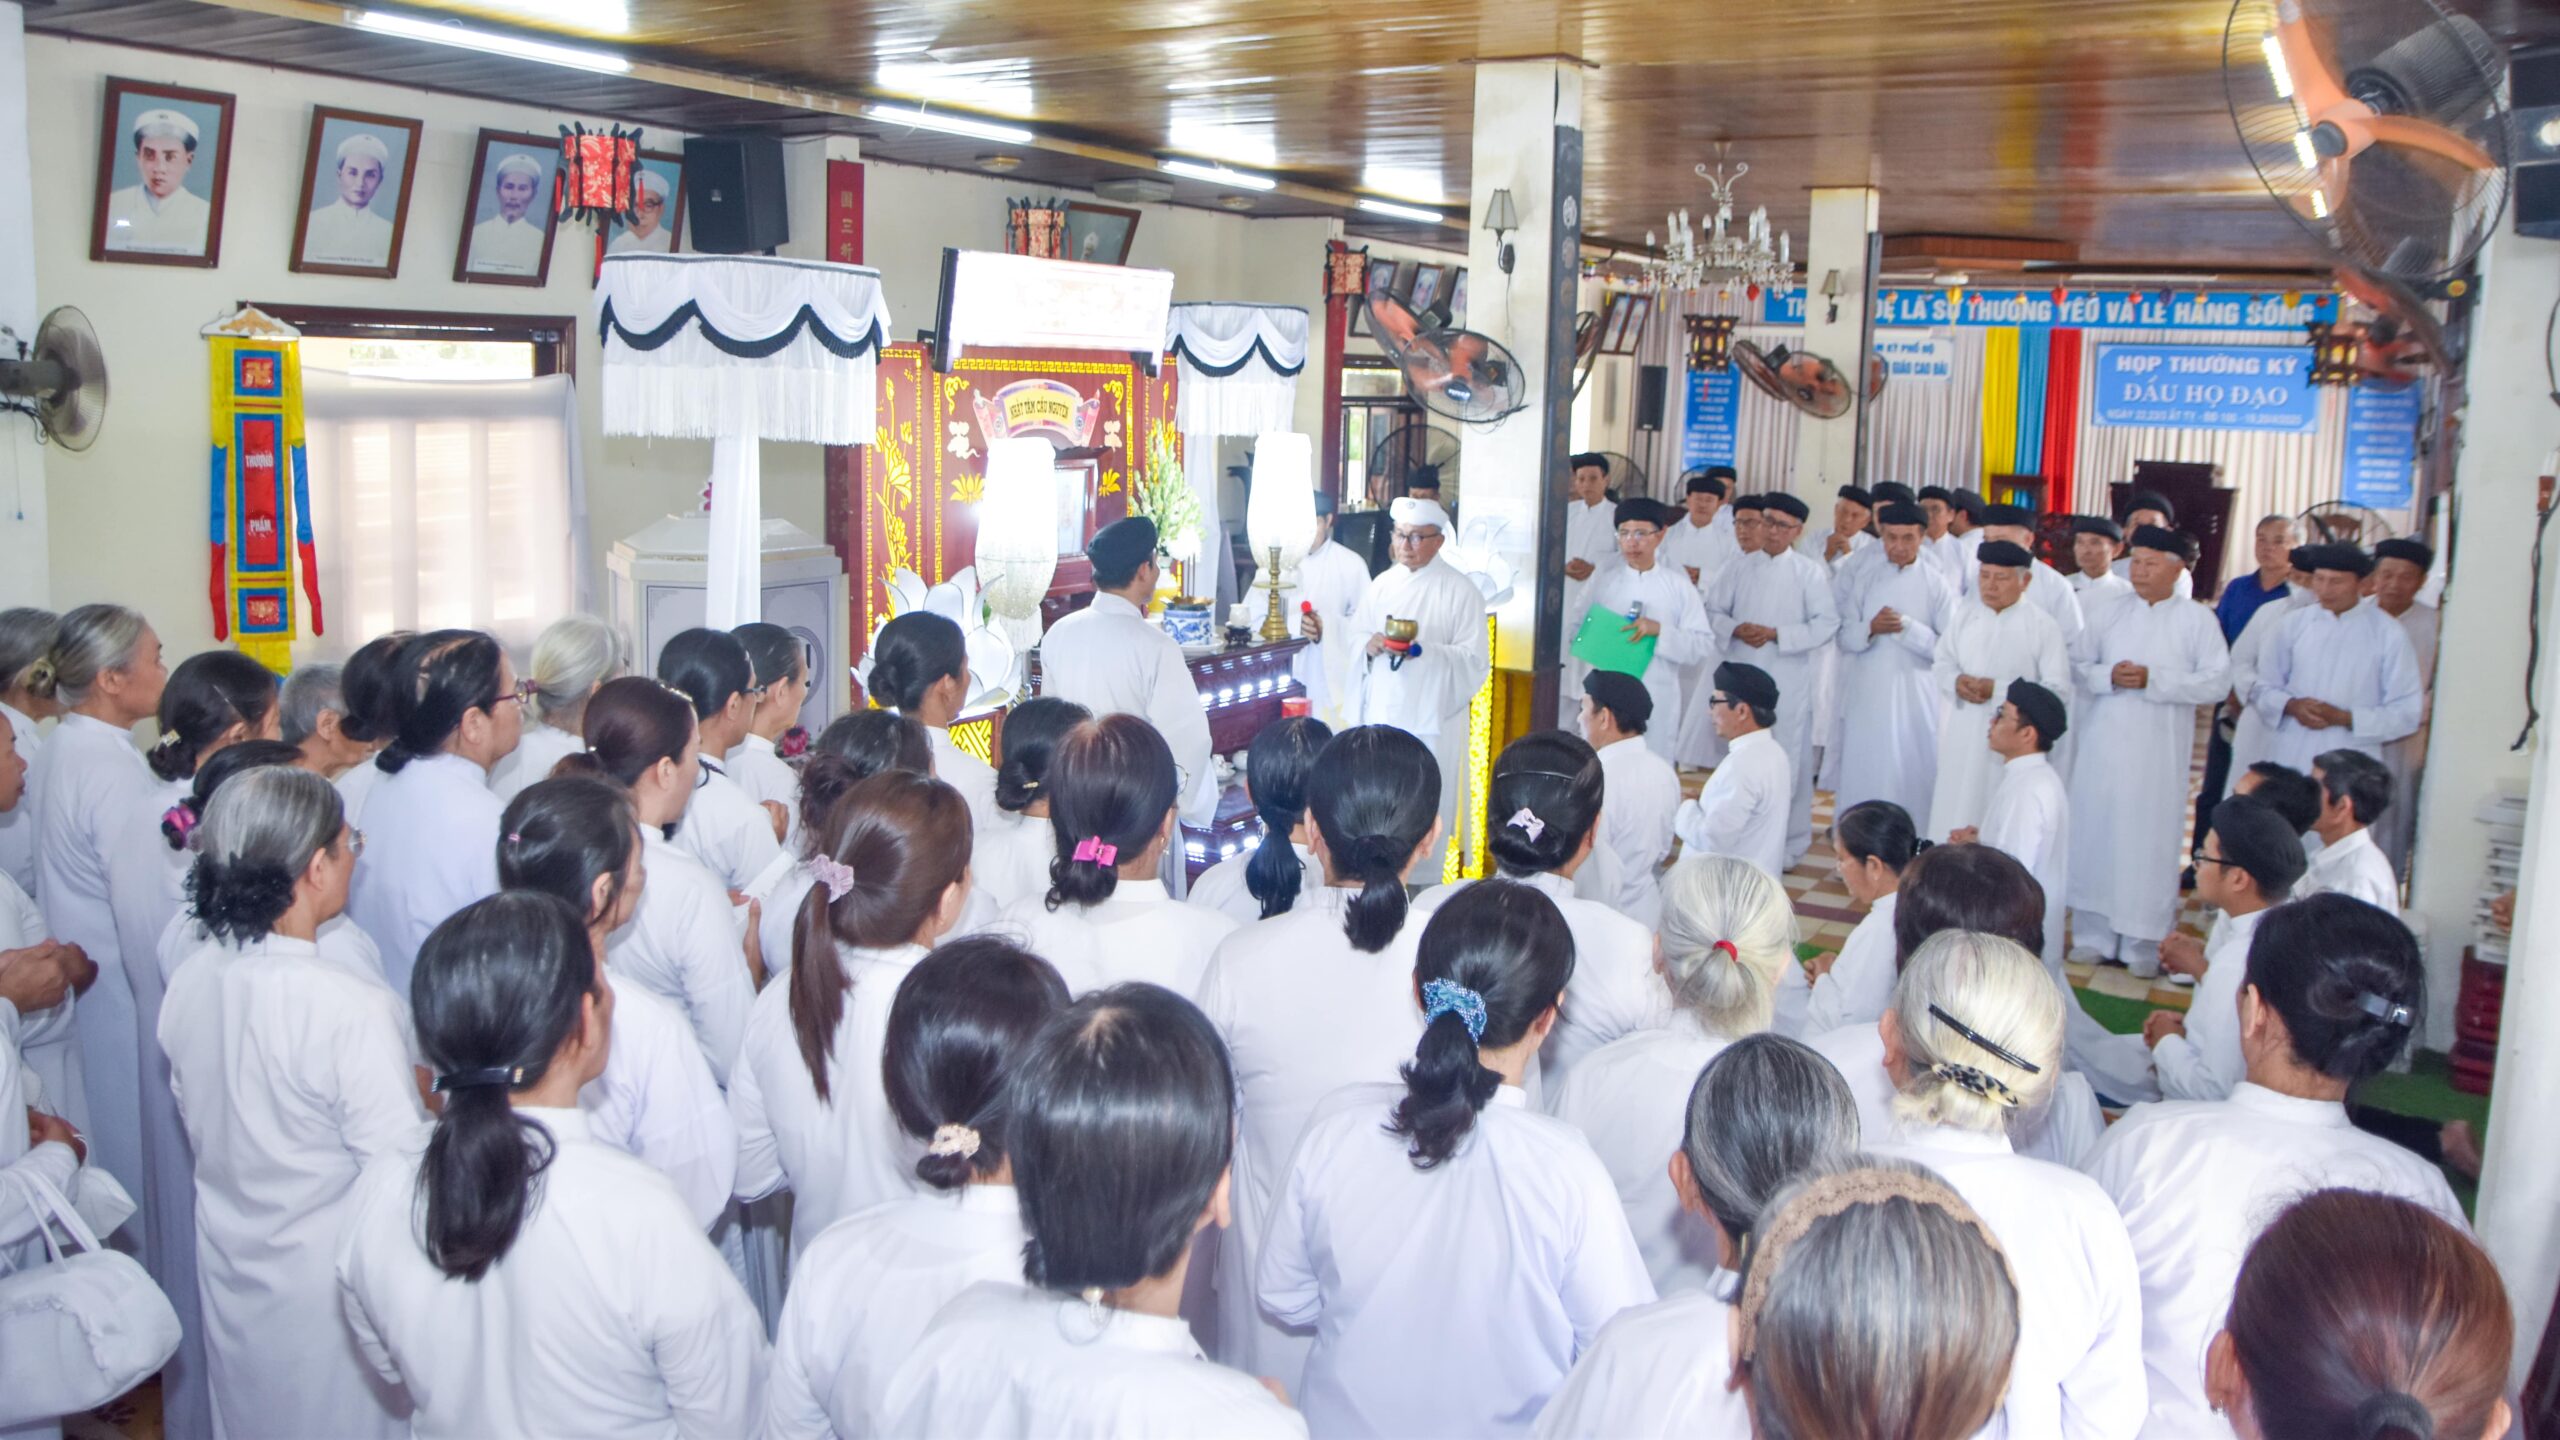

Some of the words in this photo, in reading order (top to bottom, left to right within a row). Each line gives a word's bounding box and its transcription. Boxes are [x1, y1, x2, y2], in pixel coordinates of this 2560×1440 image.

[2116, 355, 2163, 375] HỌP
[2184, 385, 2225, 408] HỌ
[2229, 386, 2289, 410] ĐẠO
